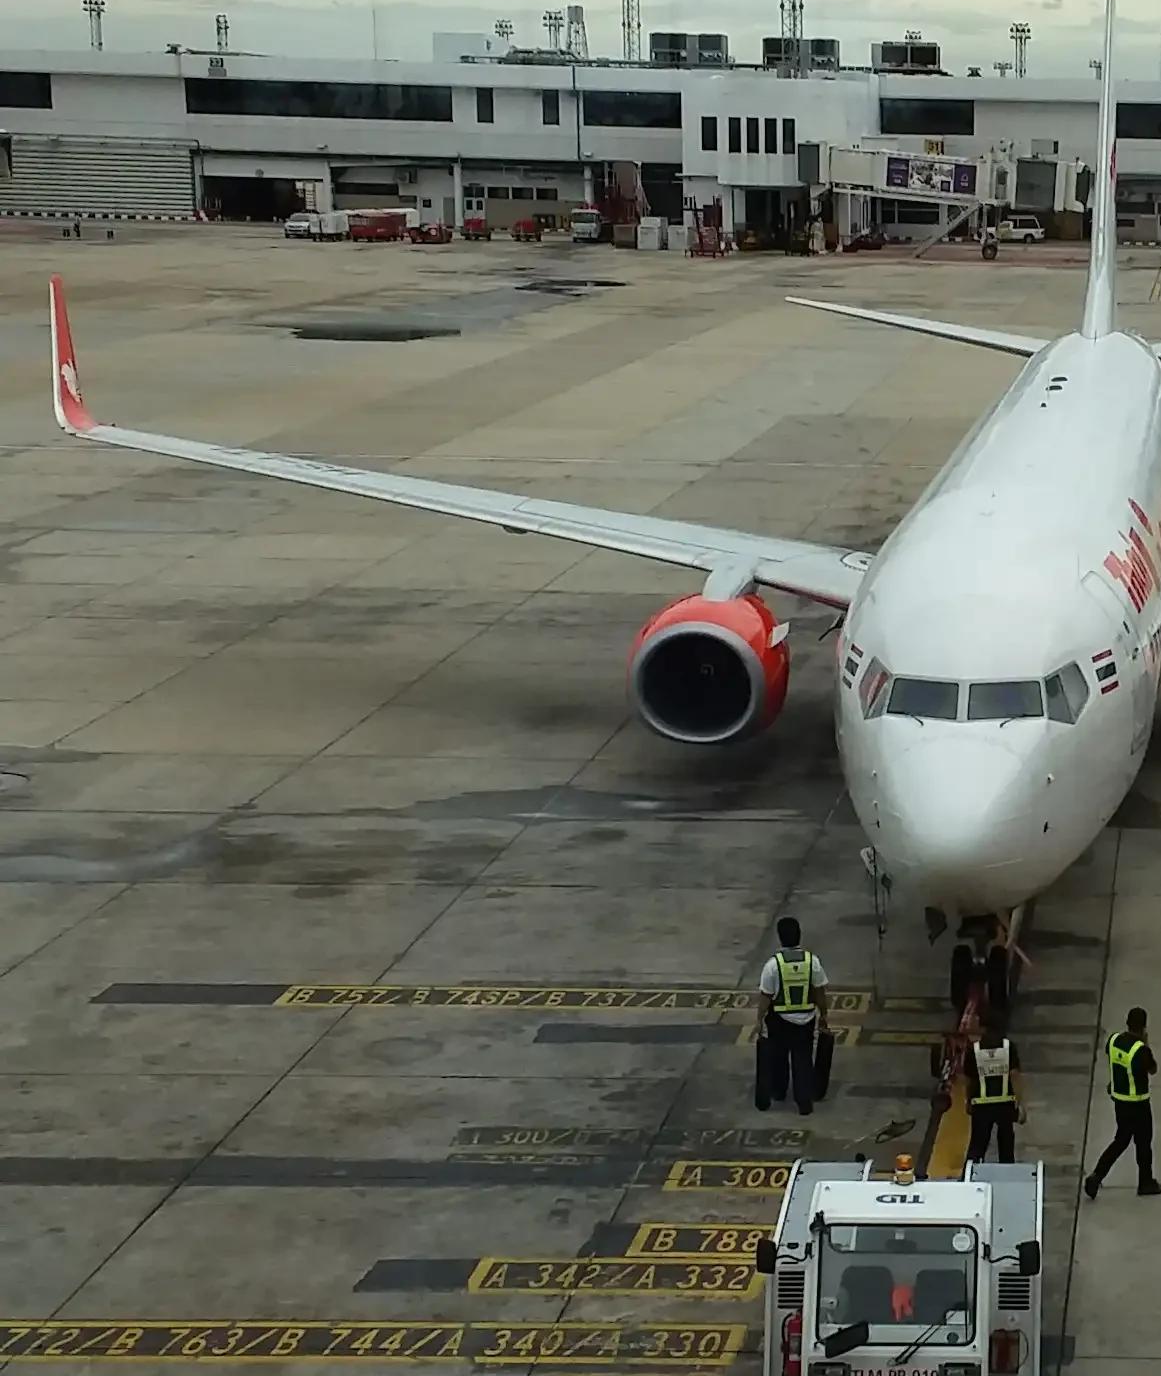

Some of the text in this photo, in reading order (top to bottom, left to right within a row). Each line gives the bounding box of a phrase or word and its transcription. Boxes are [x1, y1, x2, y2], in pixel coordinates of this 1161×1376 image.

[295, 990, 314, 1002] B
[685, 1167, 788, 1187] A 300
[652, 1229, 764, 1252] B 788
[485, 1263, 508, 1288] A
[676, 1266, 750, 1290] 332
[642, 1330, 722, 1358] 330
